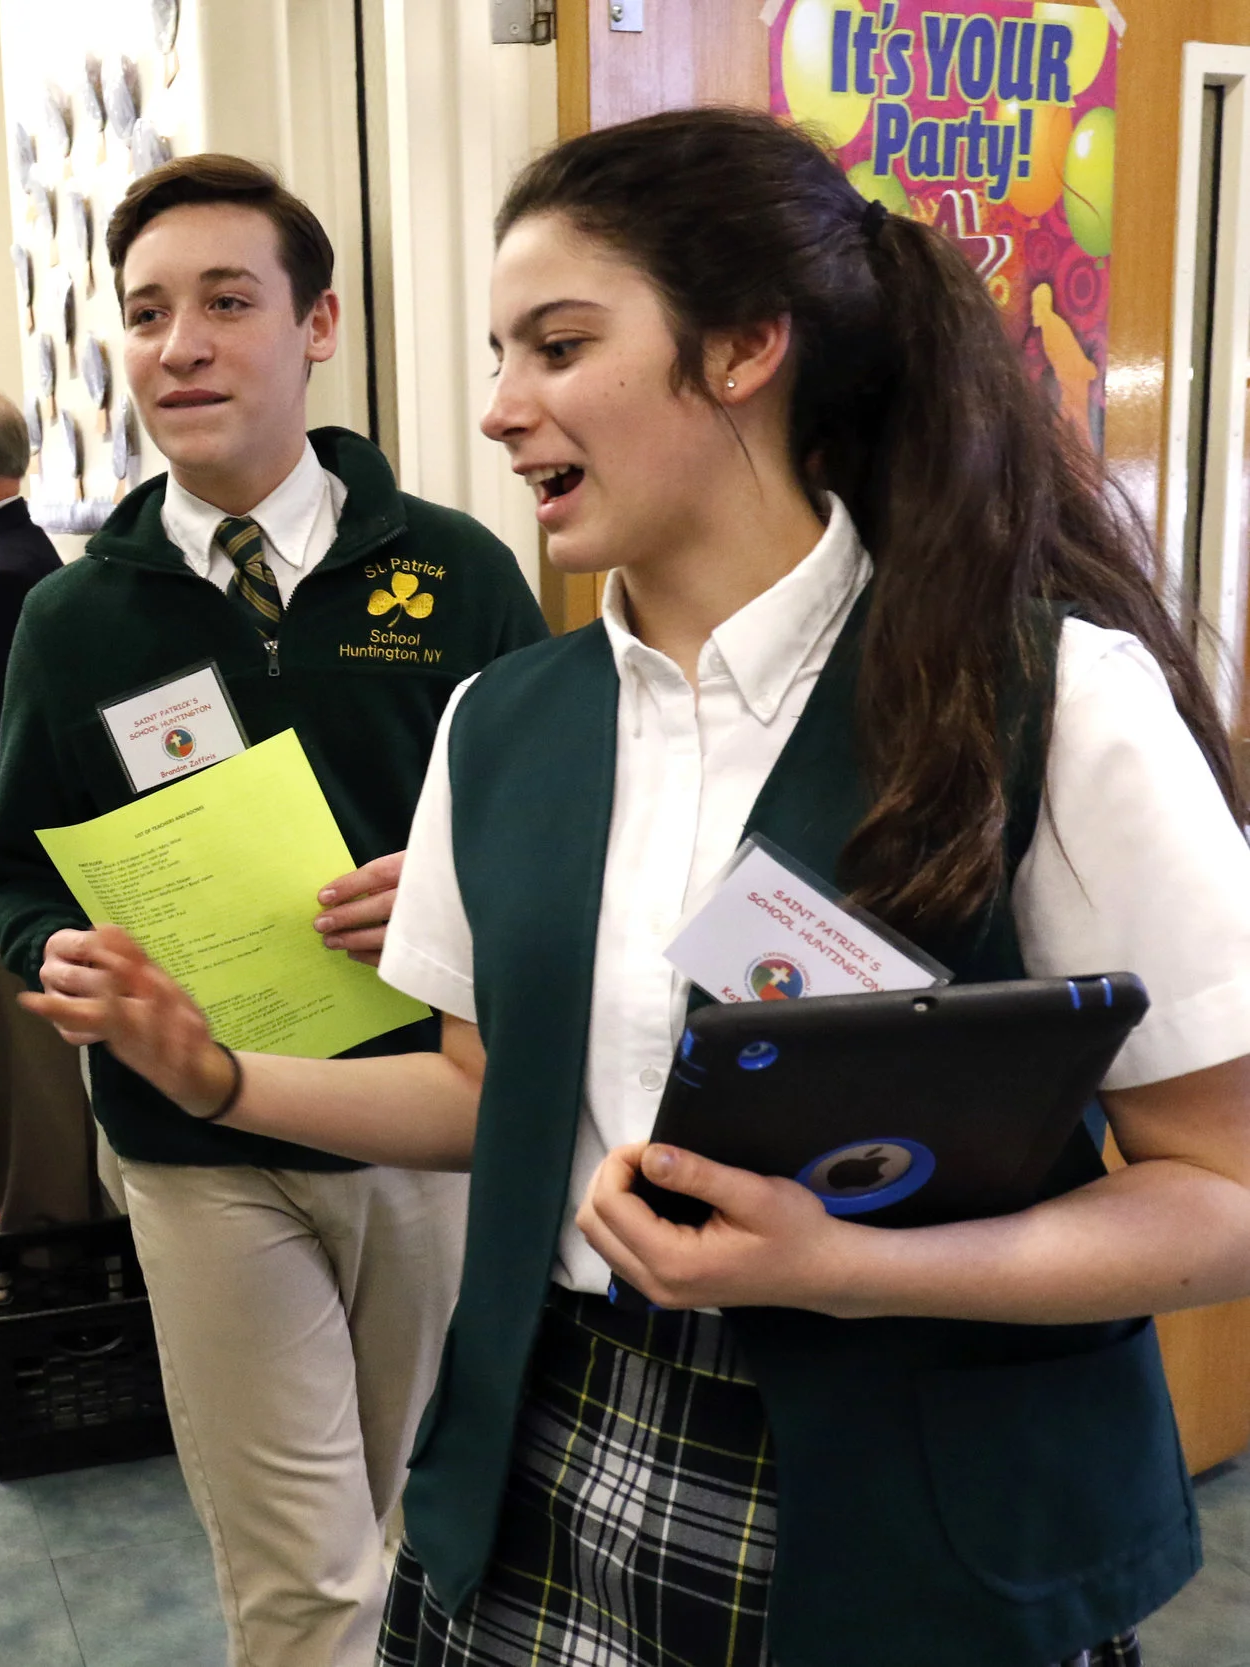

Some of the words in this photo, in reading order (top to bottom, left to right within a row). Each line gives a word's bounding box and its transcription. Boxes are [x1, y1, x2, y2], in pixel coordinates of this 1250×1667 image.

[829, 1, 915, 98] It's
[922, 13, 1075, 103] YOUR
[872, 101, 1035, 202] Party!
[390, 558, 446, 580] Patrick
[339, 644, 419, 663] Huntington,
[423, 649, 442, 663] NY
[370, 629, 420, 646] School
[129, 725, 159, 741] SCHOOL
[160, 703, 212, 728] HUNTINGTON
[134, 712, 157, 728] SAINT
[159, 697, 198, 717] PATRICK'S
[160, 764, 188, 778] Brandon
[189, 753, 217, 768] Zaffiris
[746, 891, 795, 931] SCHOOL
[773, 889, 816, 921] SAINT
[816, 920, 882, 973] PATRICK'S
